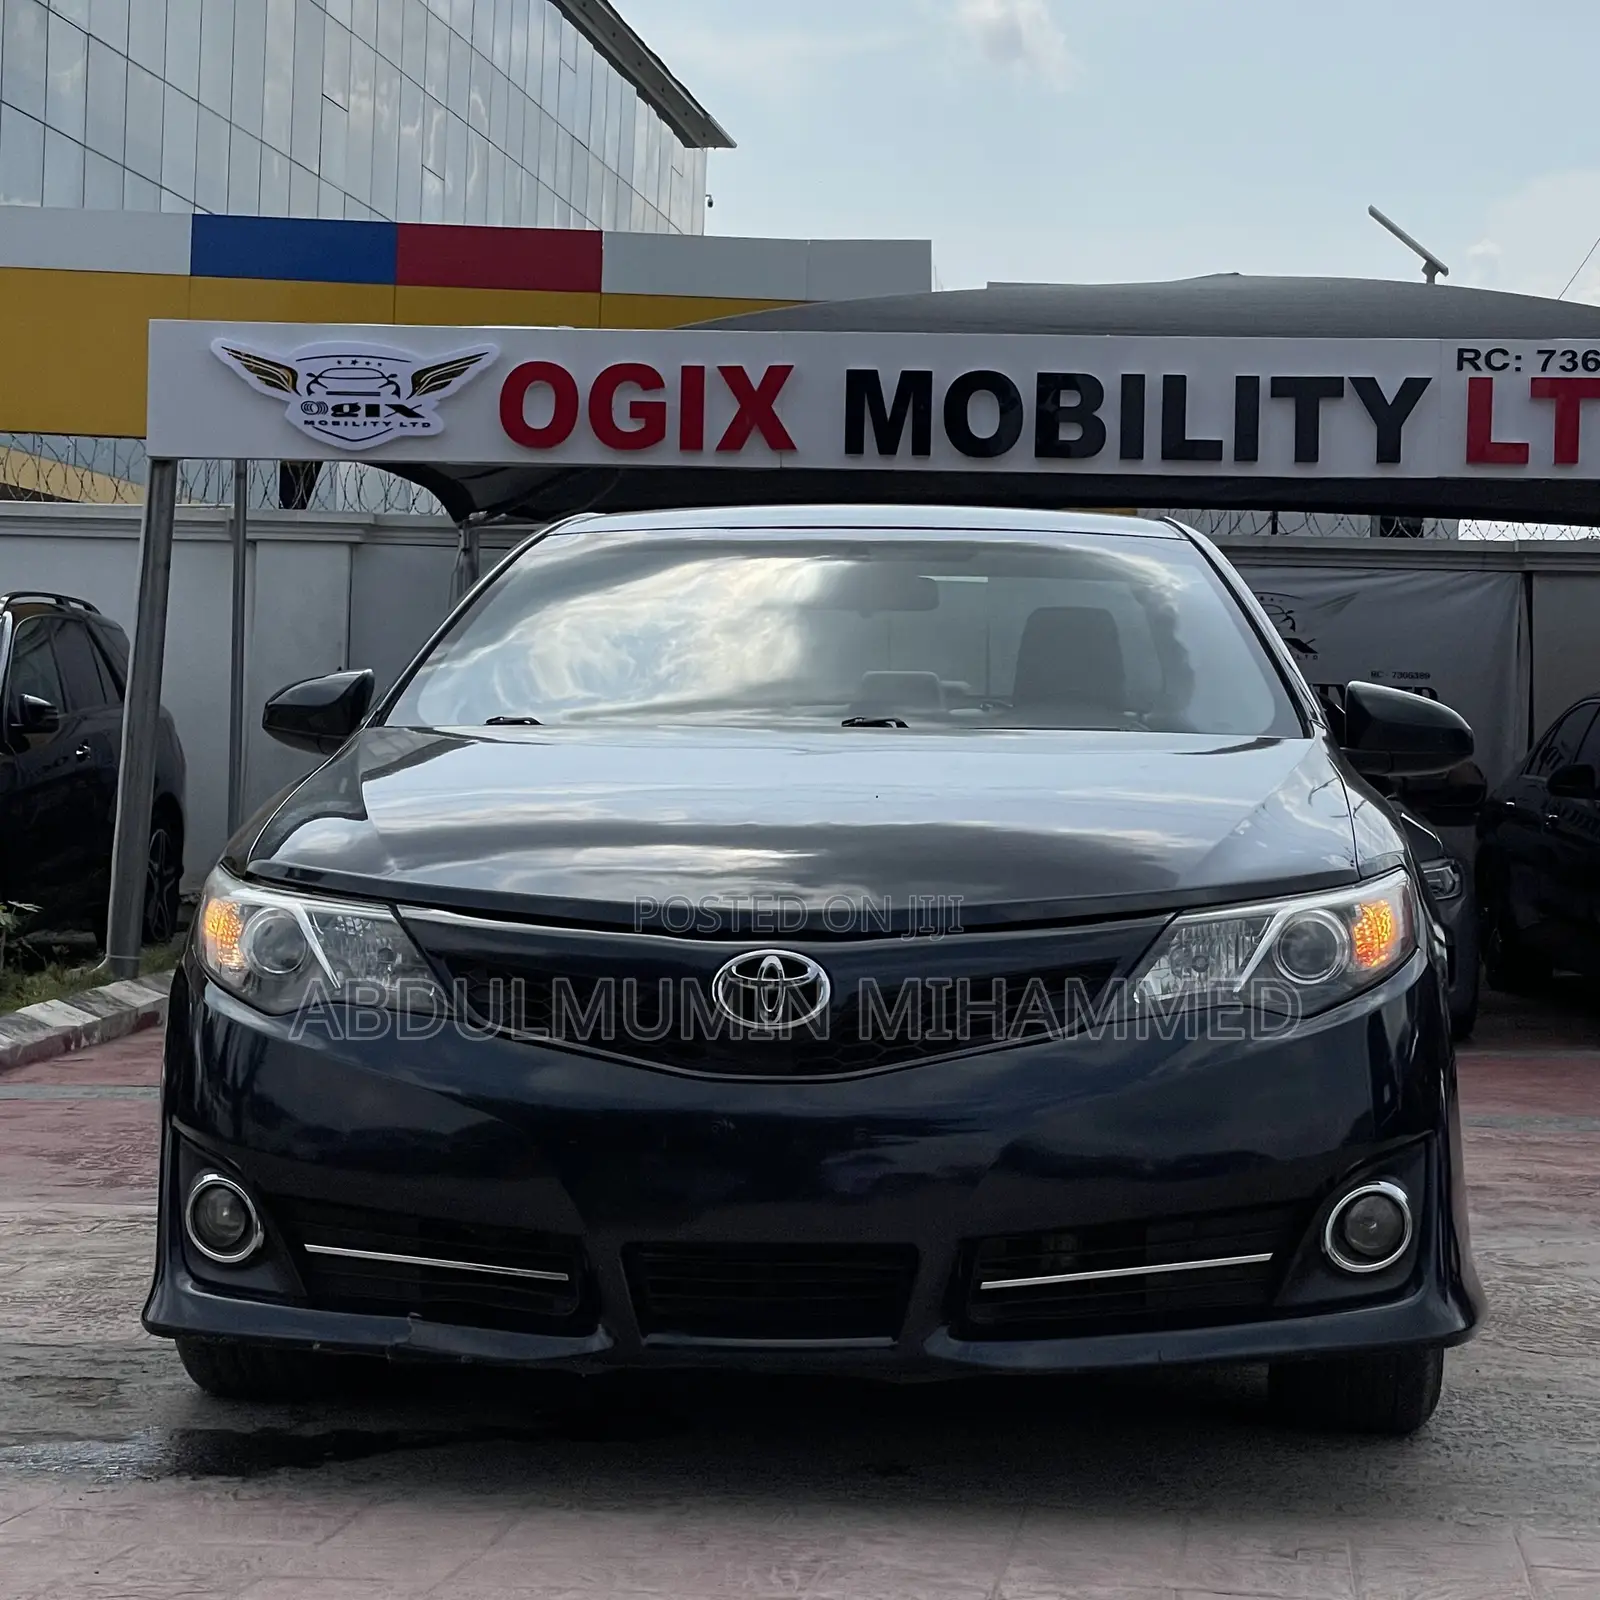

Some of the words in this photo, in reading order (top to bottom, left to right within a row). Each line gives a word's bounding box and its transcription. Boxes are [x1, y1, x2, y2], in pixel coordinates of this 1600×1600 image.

[1457, 348, 1522, 372] RC:
[1536, 349, 1600, 372] 736
[304, 419, 392, 427] MOBILITY
[499, 361, 797, 452] OGIX
[844, 369, 1432, 463] MOBILITY
[1466, 377, 1600, 465] LT
